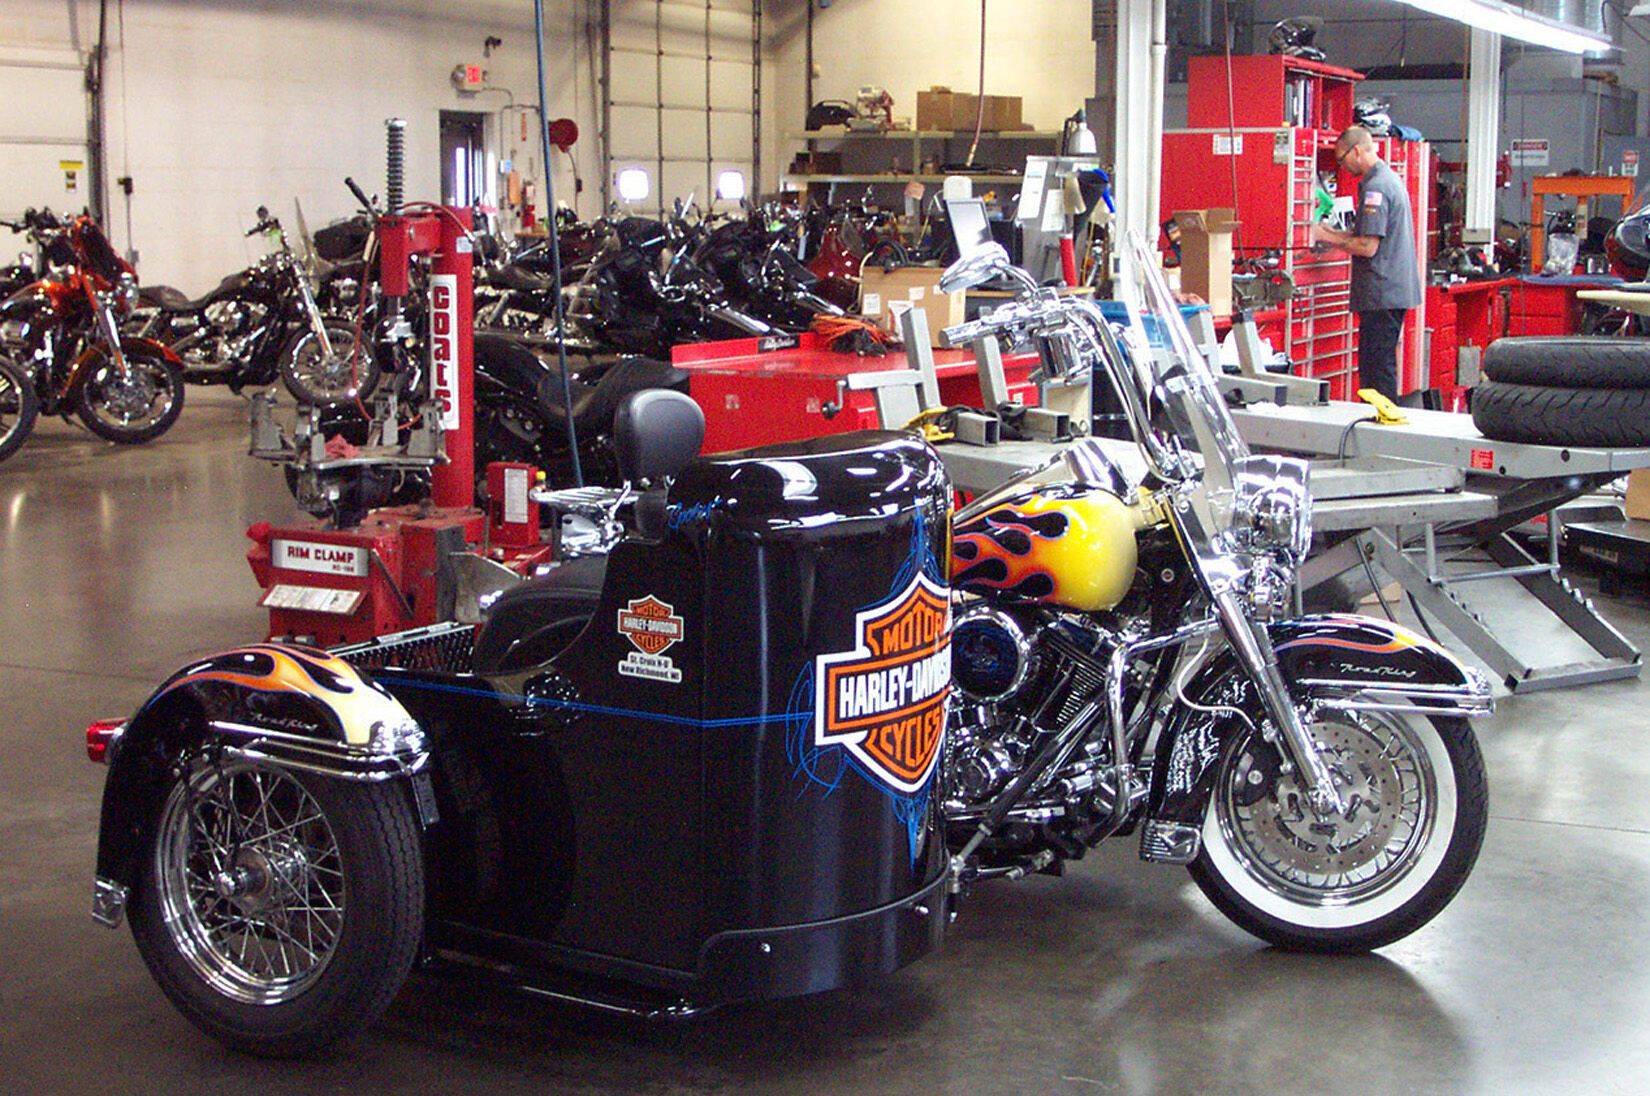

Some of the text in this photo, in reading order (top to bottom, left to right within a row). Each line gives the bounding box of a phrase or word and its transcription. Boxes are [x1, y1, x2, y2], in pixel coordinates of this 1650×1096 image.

[433, 286, 452, 412] COATS
[288, 546, 354, 563] RIM CLAMP
[637, 602, 668, 617] MOTOR
[623, 616, 678, 634] HARLEY-DAVIDSON
[882, 600, 943, 655] MOTOR
[636, 633, 667, 650] CYCLES
[621, 664, 635, 673] New
[640, 656, 656, 666] Croix
[1340, 663, 1416, 678] Road King
[880, 705, 942, 767] CYCLES
